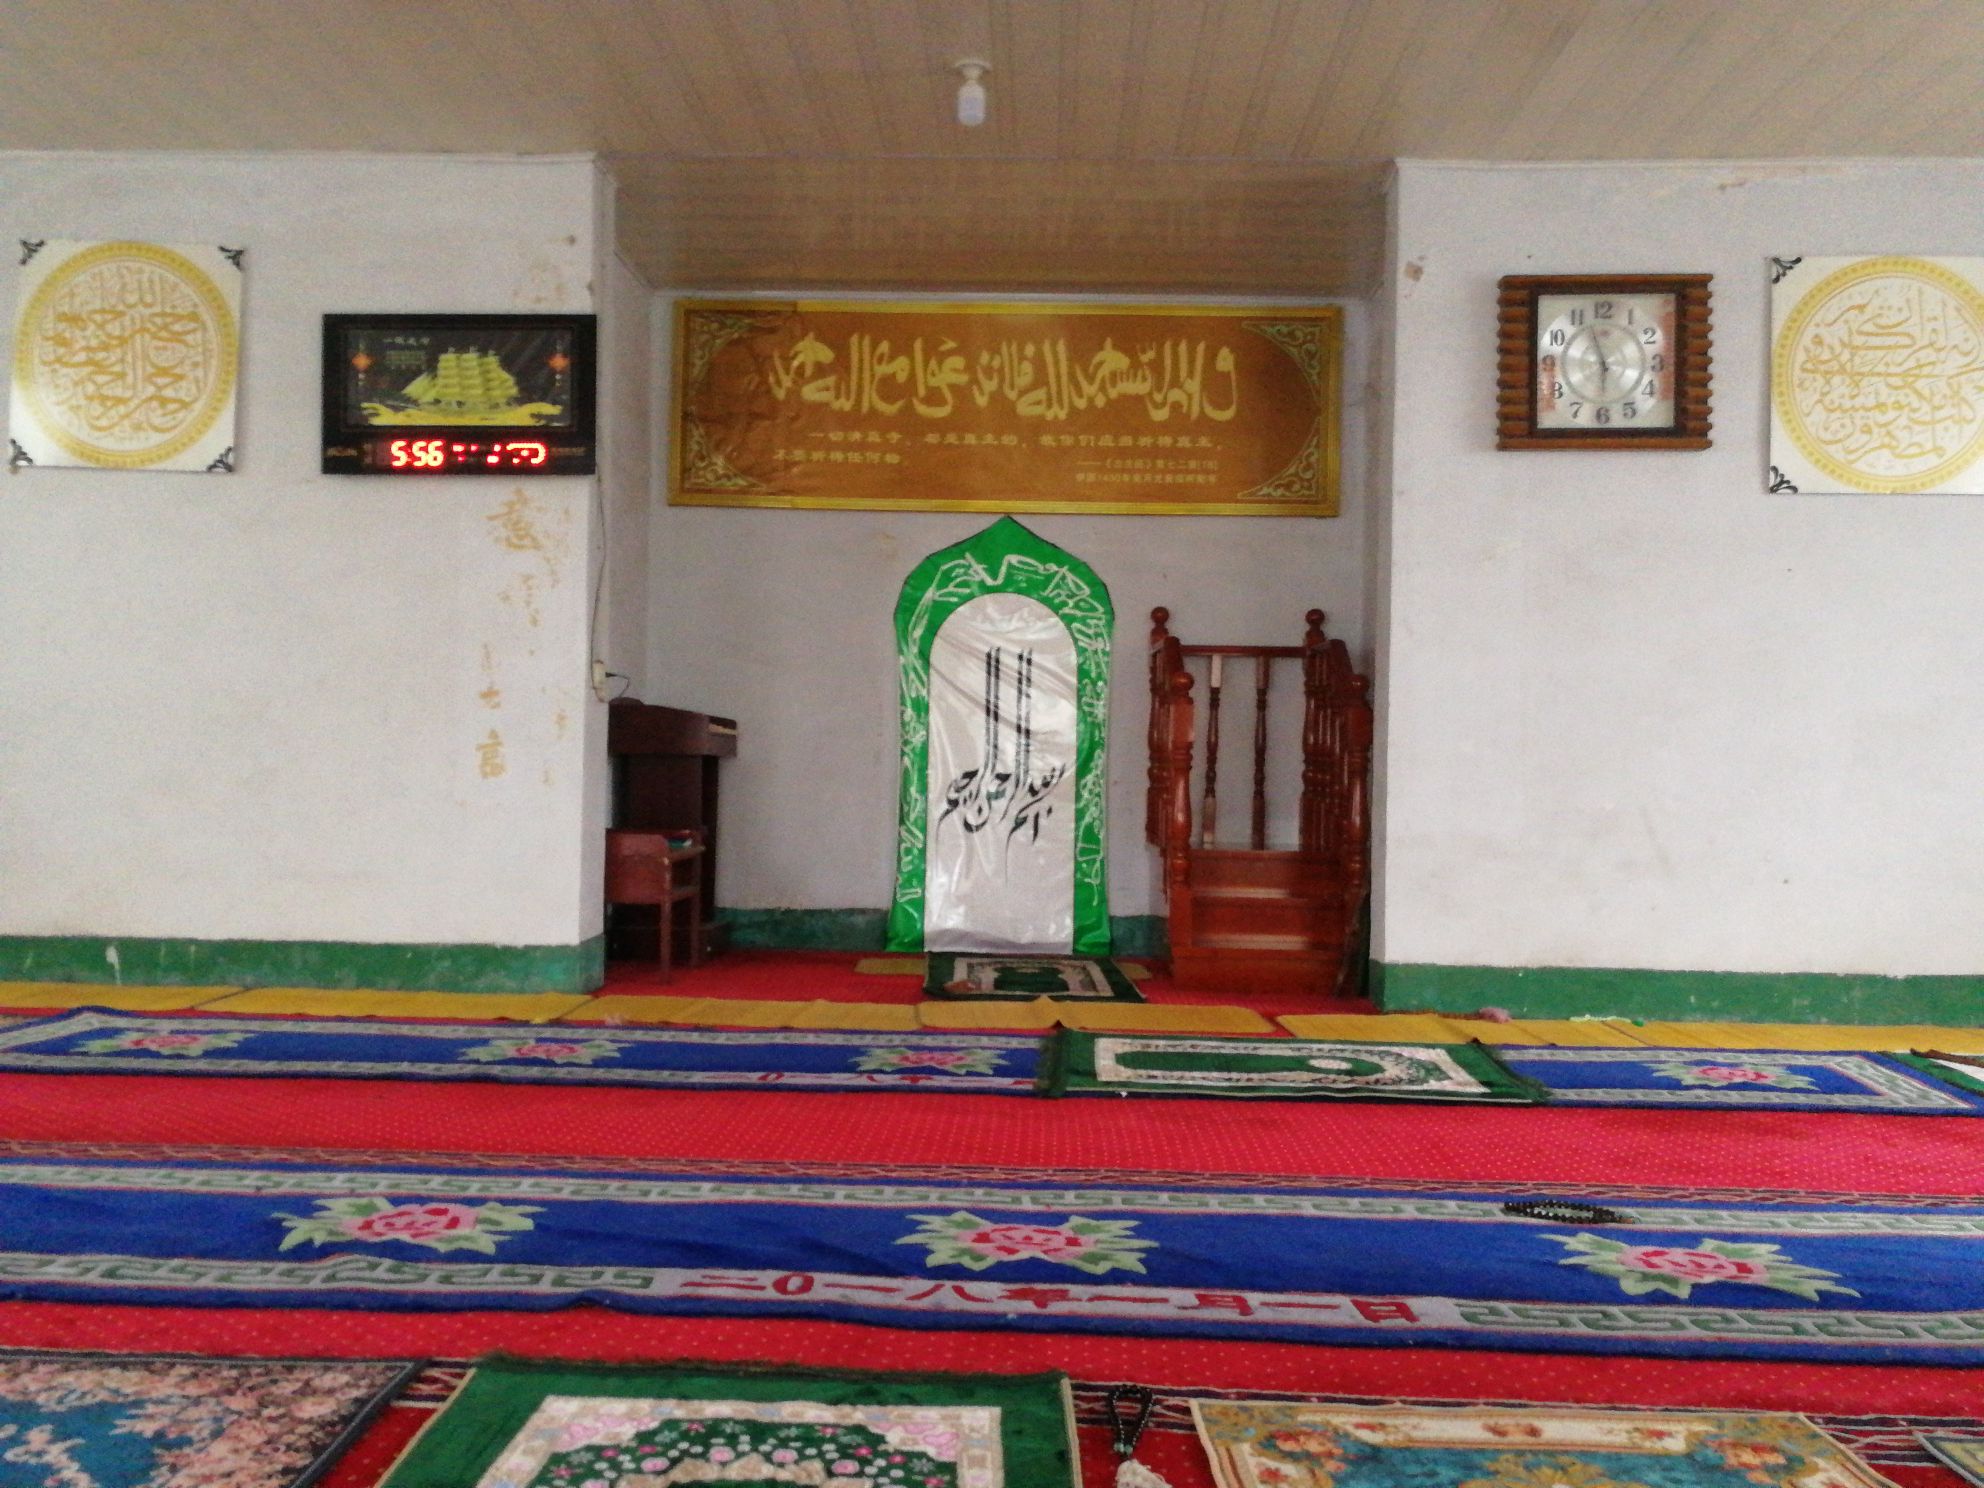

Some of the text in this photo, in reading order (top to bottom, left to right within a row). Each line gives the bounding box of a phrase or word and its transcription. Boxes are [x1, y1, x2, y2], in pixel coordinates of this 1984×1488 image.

[1570, 309, 1584, 326] 11
[1594, 301, 1613, 319] 12
[1627, 308, 1634, 325] 1
[1549, 329, 1565, 346] 10
[1643, 327, 1656, 345] 2
[1651, 354, 1665, 372] 3
[1641, 379, 1656, 398] 4
[1569, 401, 1583, 419] 7
[1595, 407, 1610, 424] 6
[1623, 402, 1636, 419] 5
